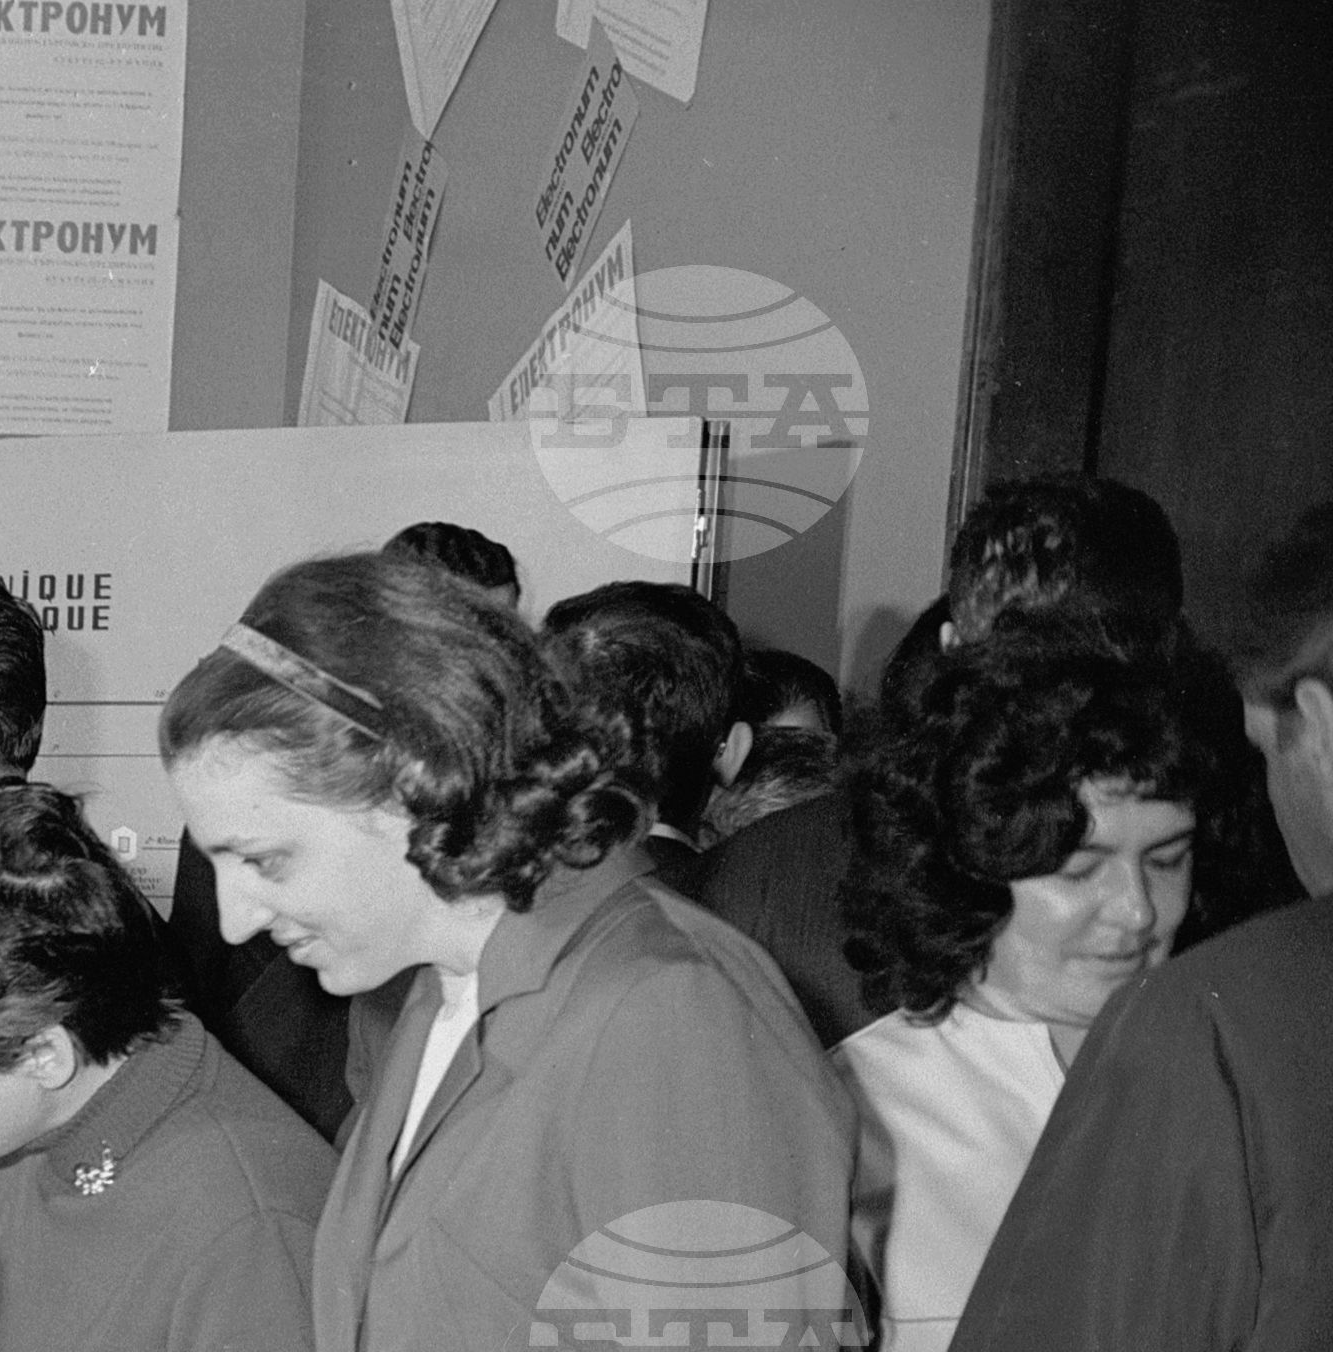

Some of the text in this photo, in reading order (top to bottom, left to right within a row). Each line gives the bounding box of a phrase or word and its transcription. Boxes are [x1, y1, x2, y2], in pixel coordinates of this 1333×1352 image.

[403, 140, 433, 242] Electro
[536, 65, 600, 230] Electronum
[581, 56, 623, 166] Electro
[389, 188, 436, 350] Electronum
[555, 117, 622, 283] Electronum
